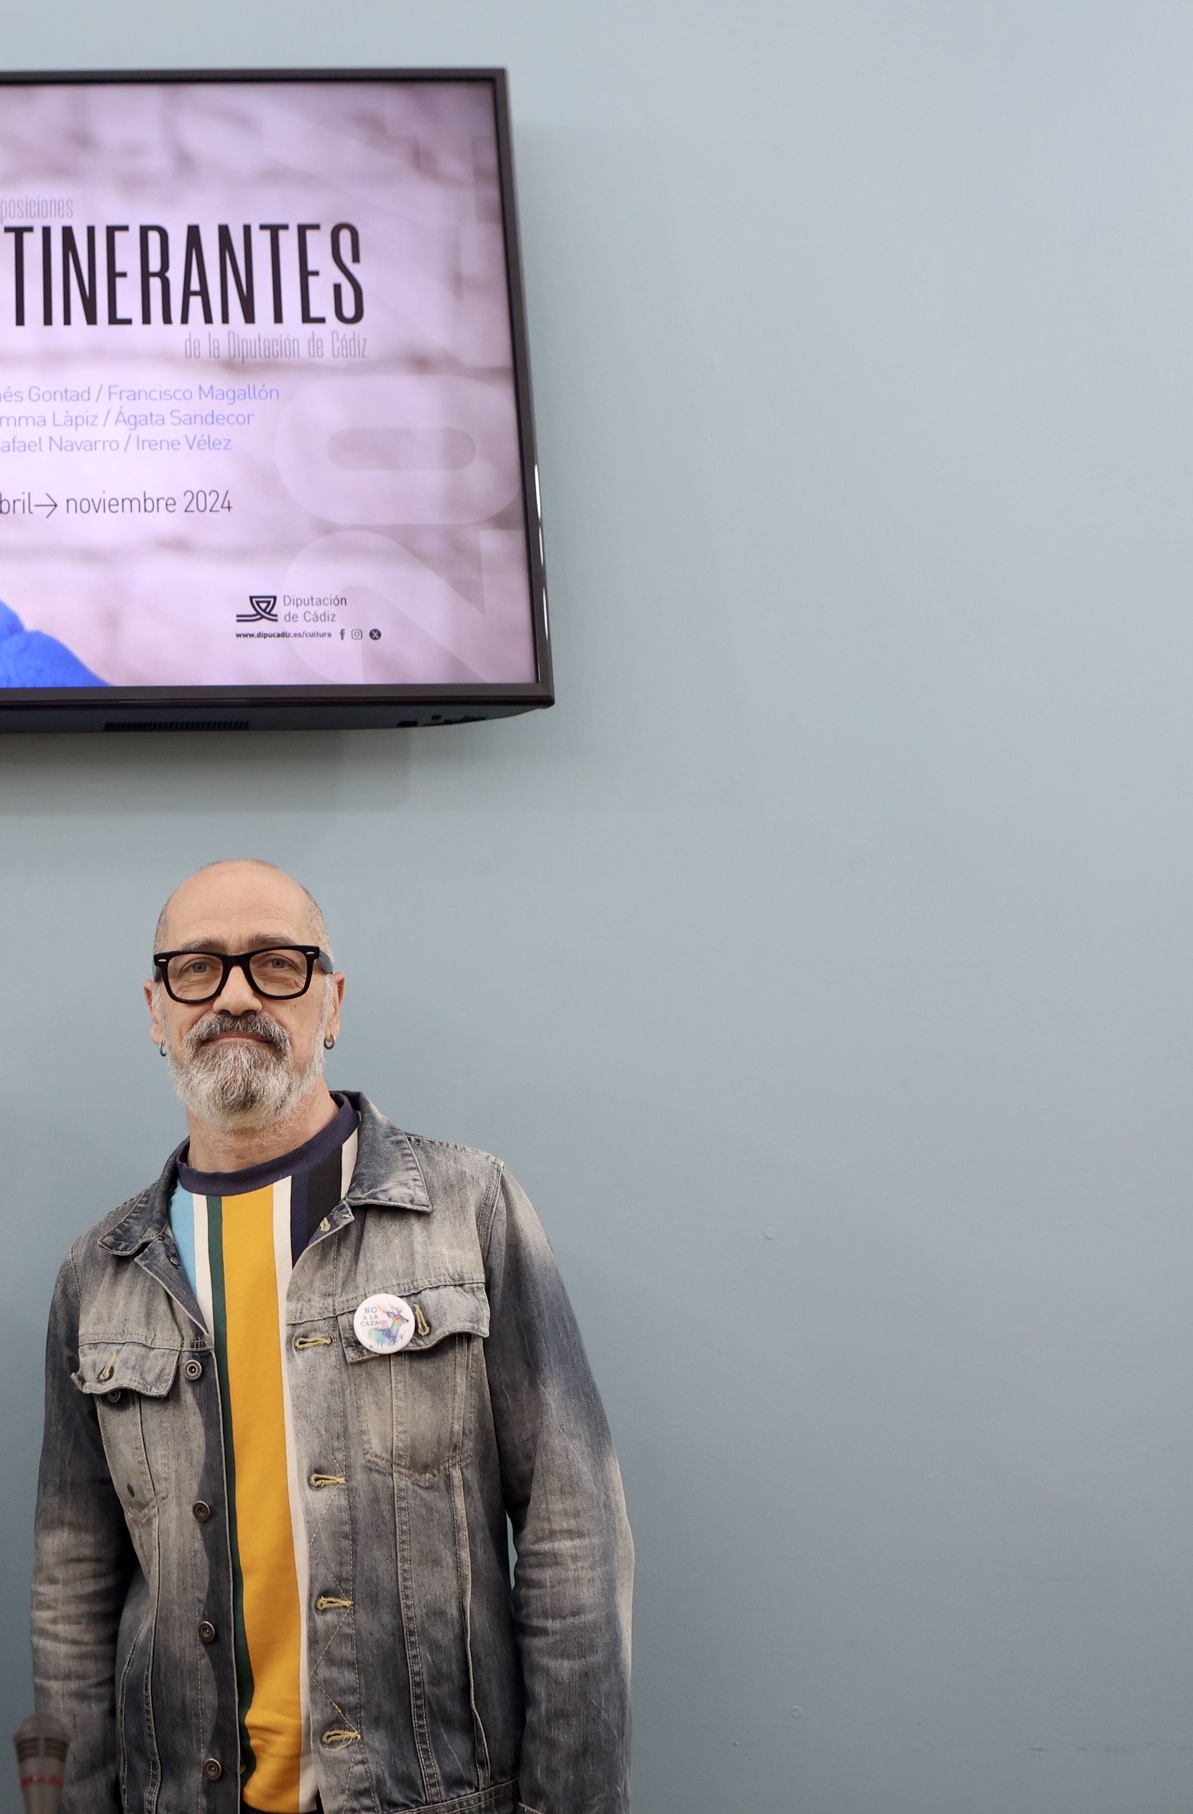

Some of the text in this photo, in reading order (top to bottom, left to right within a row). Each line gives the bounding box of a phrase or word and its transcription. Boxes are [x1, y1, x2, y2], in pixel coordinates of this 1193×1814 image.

[184, 330, 368, 364] de la Diputación de Cádiz
[28, 385, 91, 403] Gontad
[108, 384, 193, 402] Francisco
[199, 383, 280, 406] Magallón
[114, 406, 166, 431] Ágata
[170, 408, 255, 427] Sandecor
[49, 435, 120, 452] Navarro
[136, 435, 181, 451] Irene
[185, 434, 232, 451] Vélez
[65, 491, 177, 514] noviembre
[183, 489, 233, 513] 2024
[283, 594, 348, 608] Diputación
[284, 610, 336, 623] de Cádiz
[235, 630, 332, 640] www.dipucadiz.es/cultura
